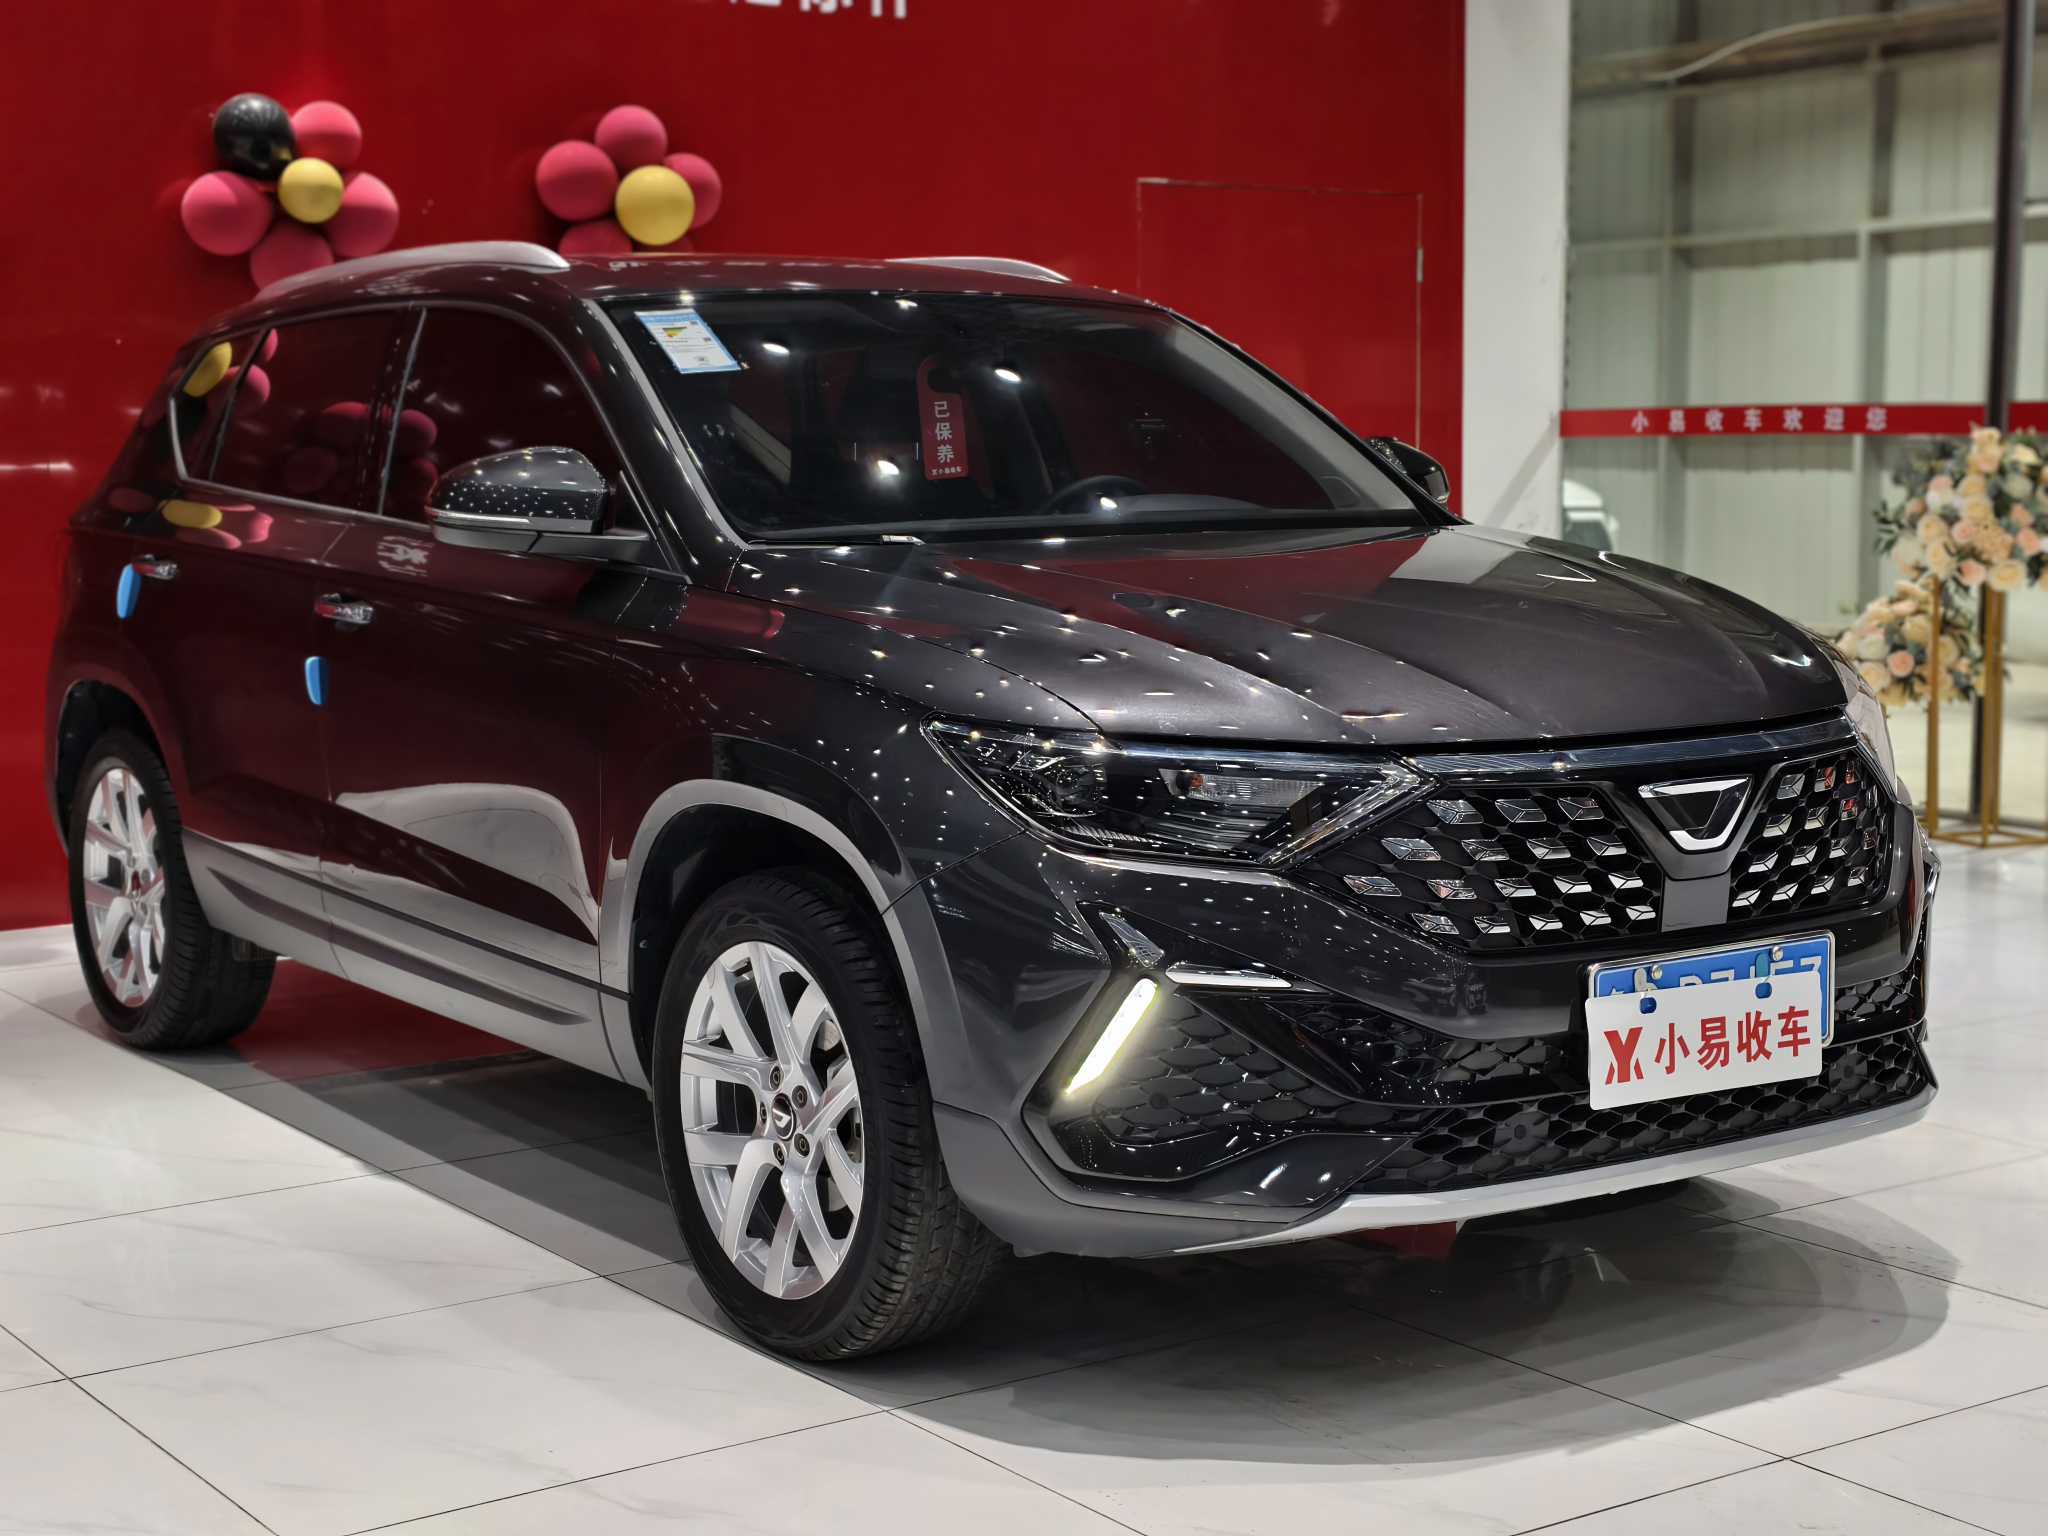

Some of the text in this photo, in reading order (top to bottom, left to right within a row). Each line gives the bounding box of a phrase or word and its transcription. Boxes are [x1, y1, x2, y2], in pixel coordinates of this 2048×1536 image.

[934, 401, 956, 463] 已保养
[1631, 407, 1888, 432] 小易收车欢迎您
[1655, 1006, 1811, 1075] 小易收车
